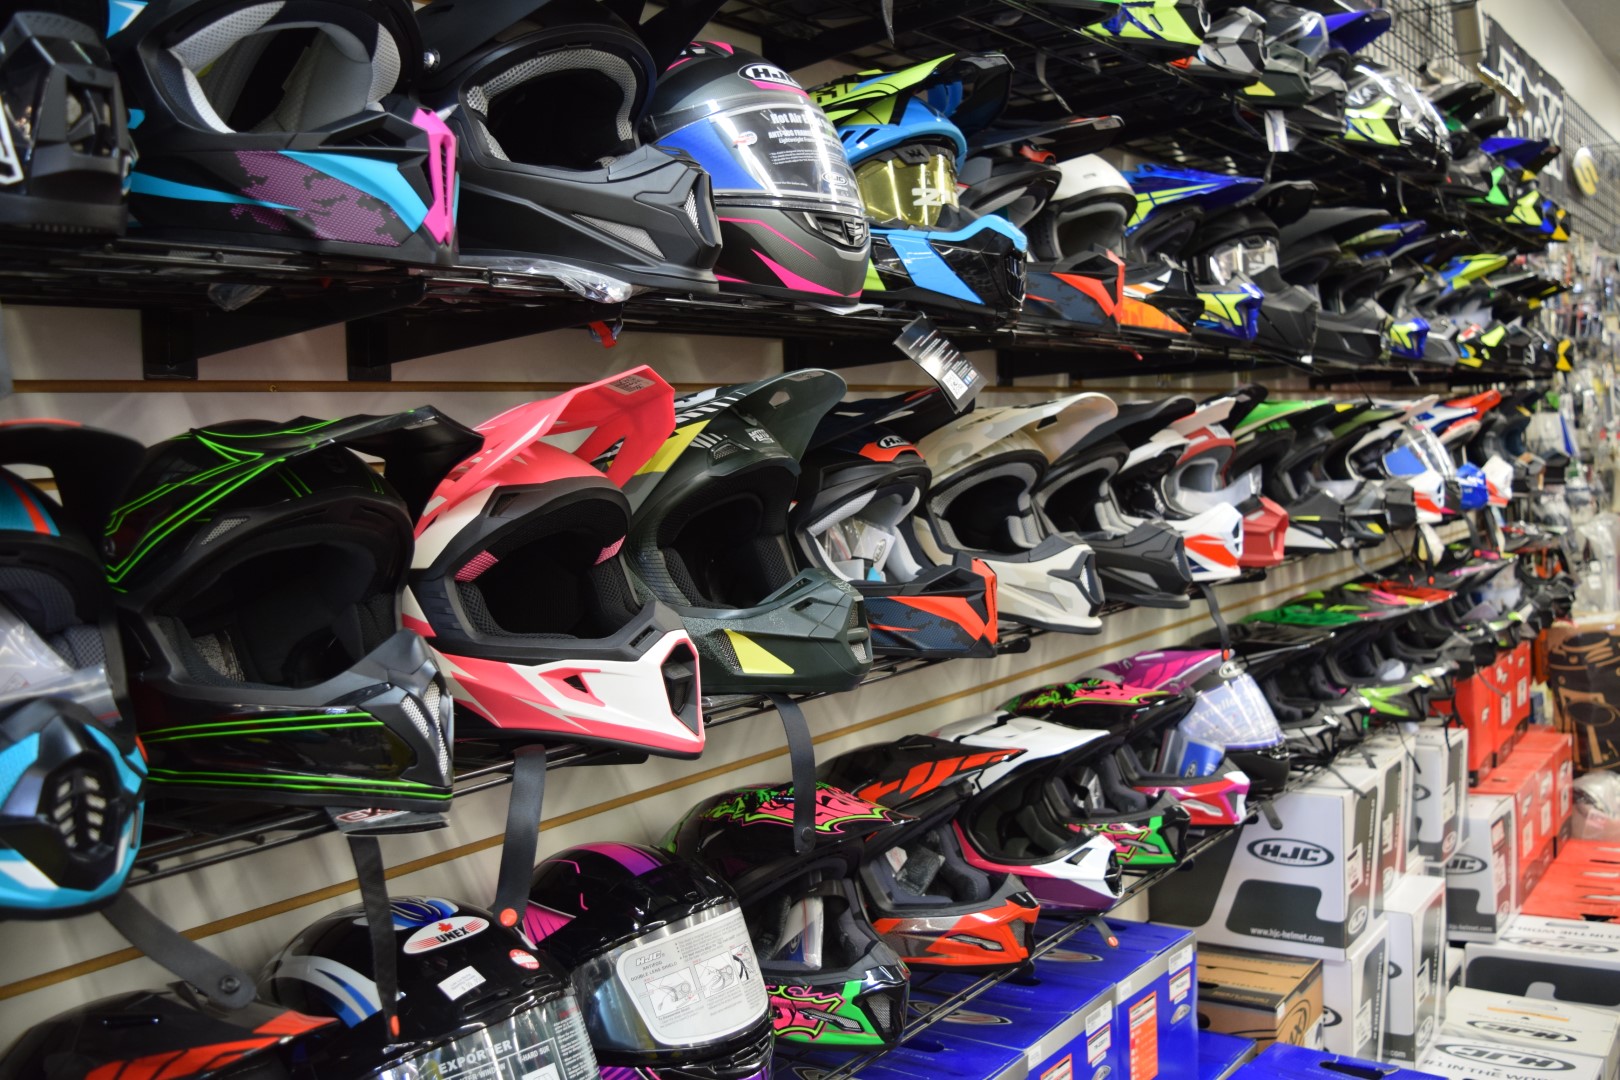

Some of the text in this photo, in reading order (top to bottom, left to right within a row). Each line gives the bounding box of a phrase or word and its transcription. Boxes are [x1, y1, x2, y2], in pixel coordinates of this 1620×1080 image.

[1259, 843, 1321, 862] HJC
[1446, 859, 1476, 870] JC
[435, 926, 470, 943] UNEX
[1250, 926, 1324, 944] www.hjc-helmet.com
[635, 950, 662, 967] HJC
[439, 1039, 513, 1075] EXPORTER
[1470, 1067, 1501, 1078] THE
